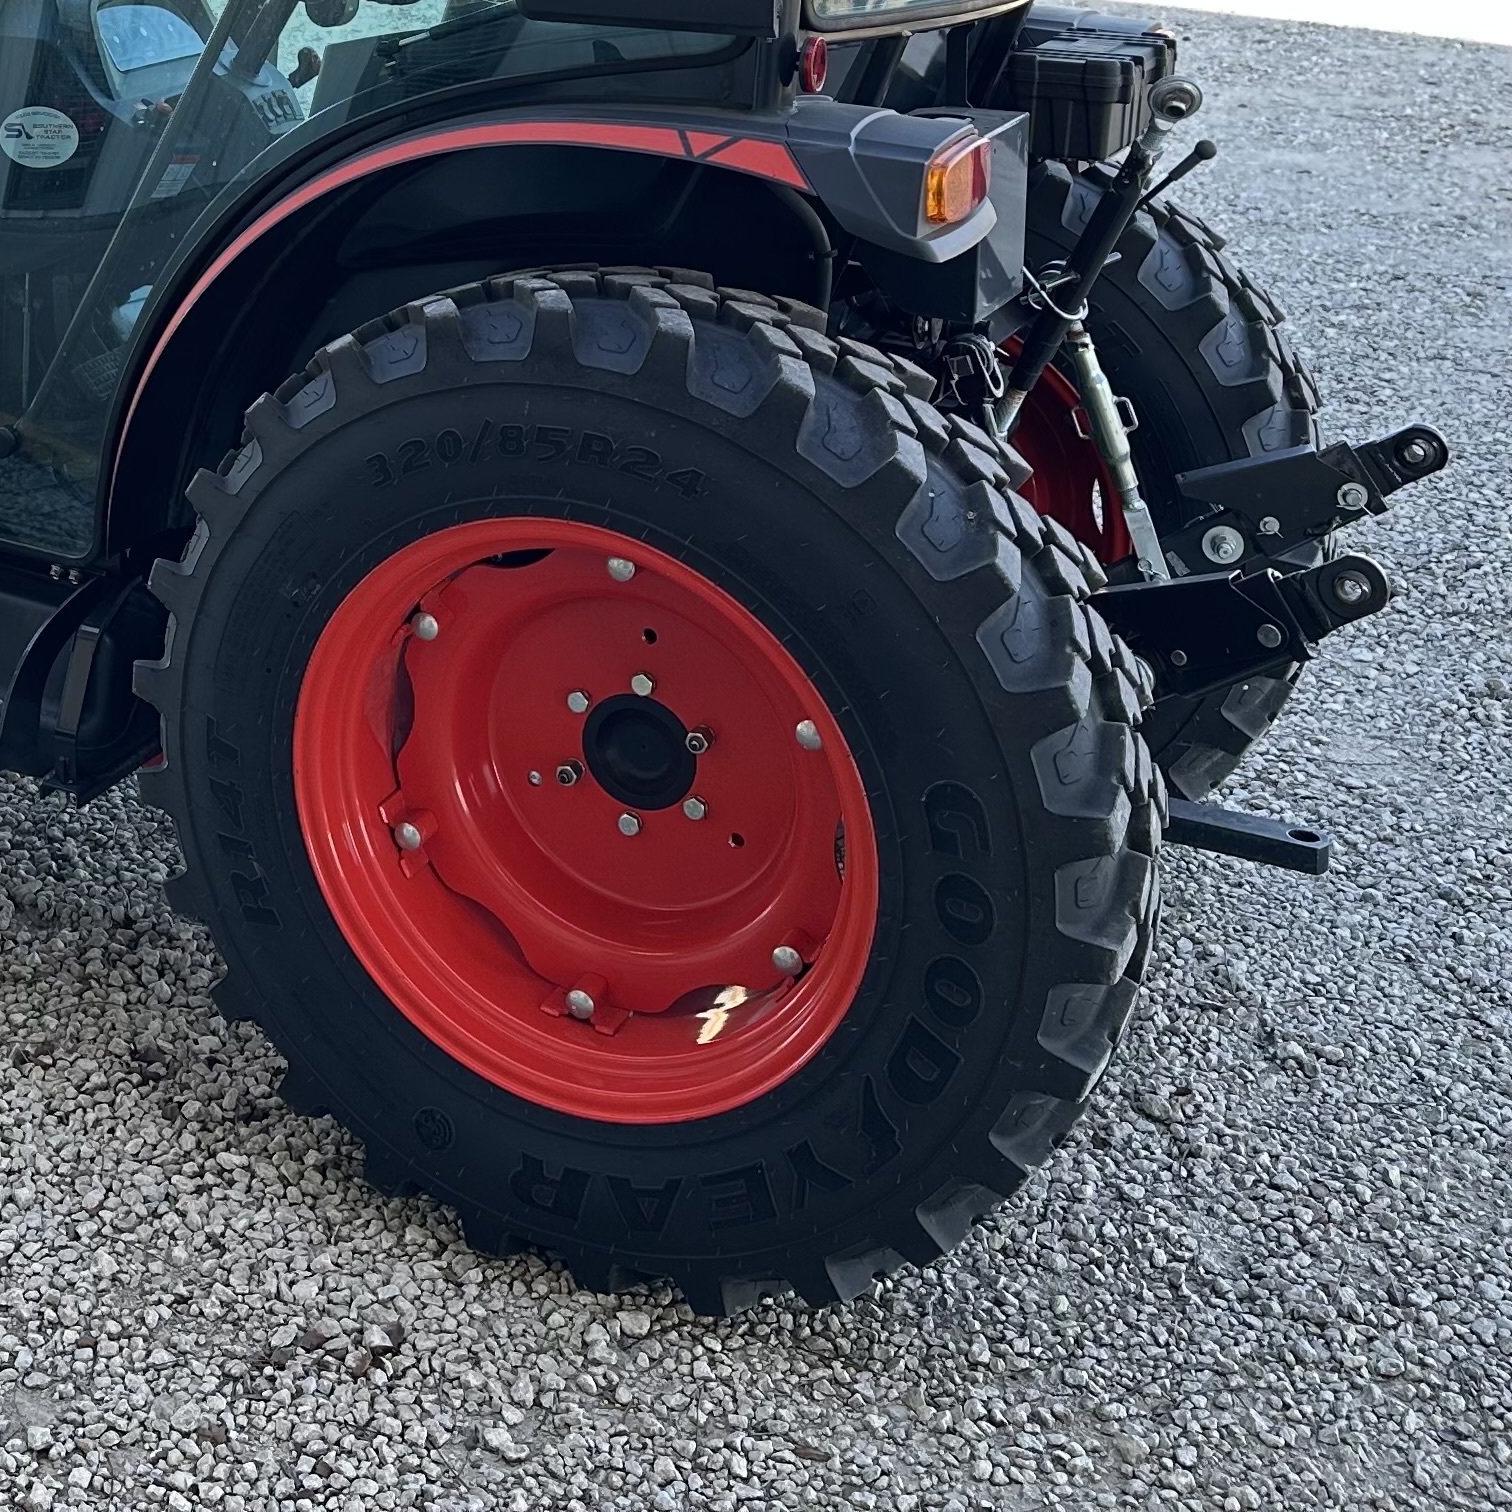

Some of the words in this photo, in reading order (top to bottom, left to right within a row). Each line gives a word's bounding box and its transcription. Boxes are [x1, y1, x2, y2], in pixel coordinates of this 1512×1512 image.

[364, 417, 710, 501] 320/85R24
[206, 712, 284, 931] R14T
[508, 779, 997, 1239] GOODYEAR
